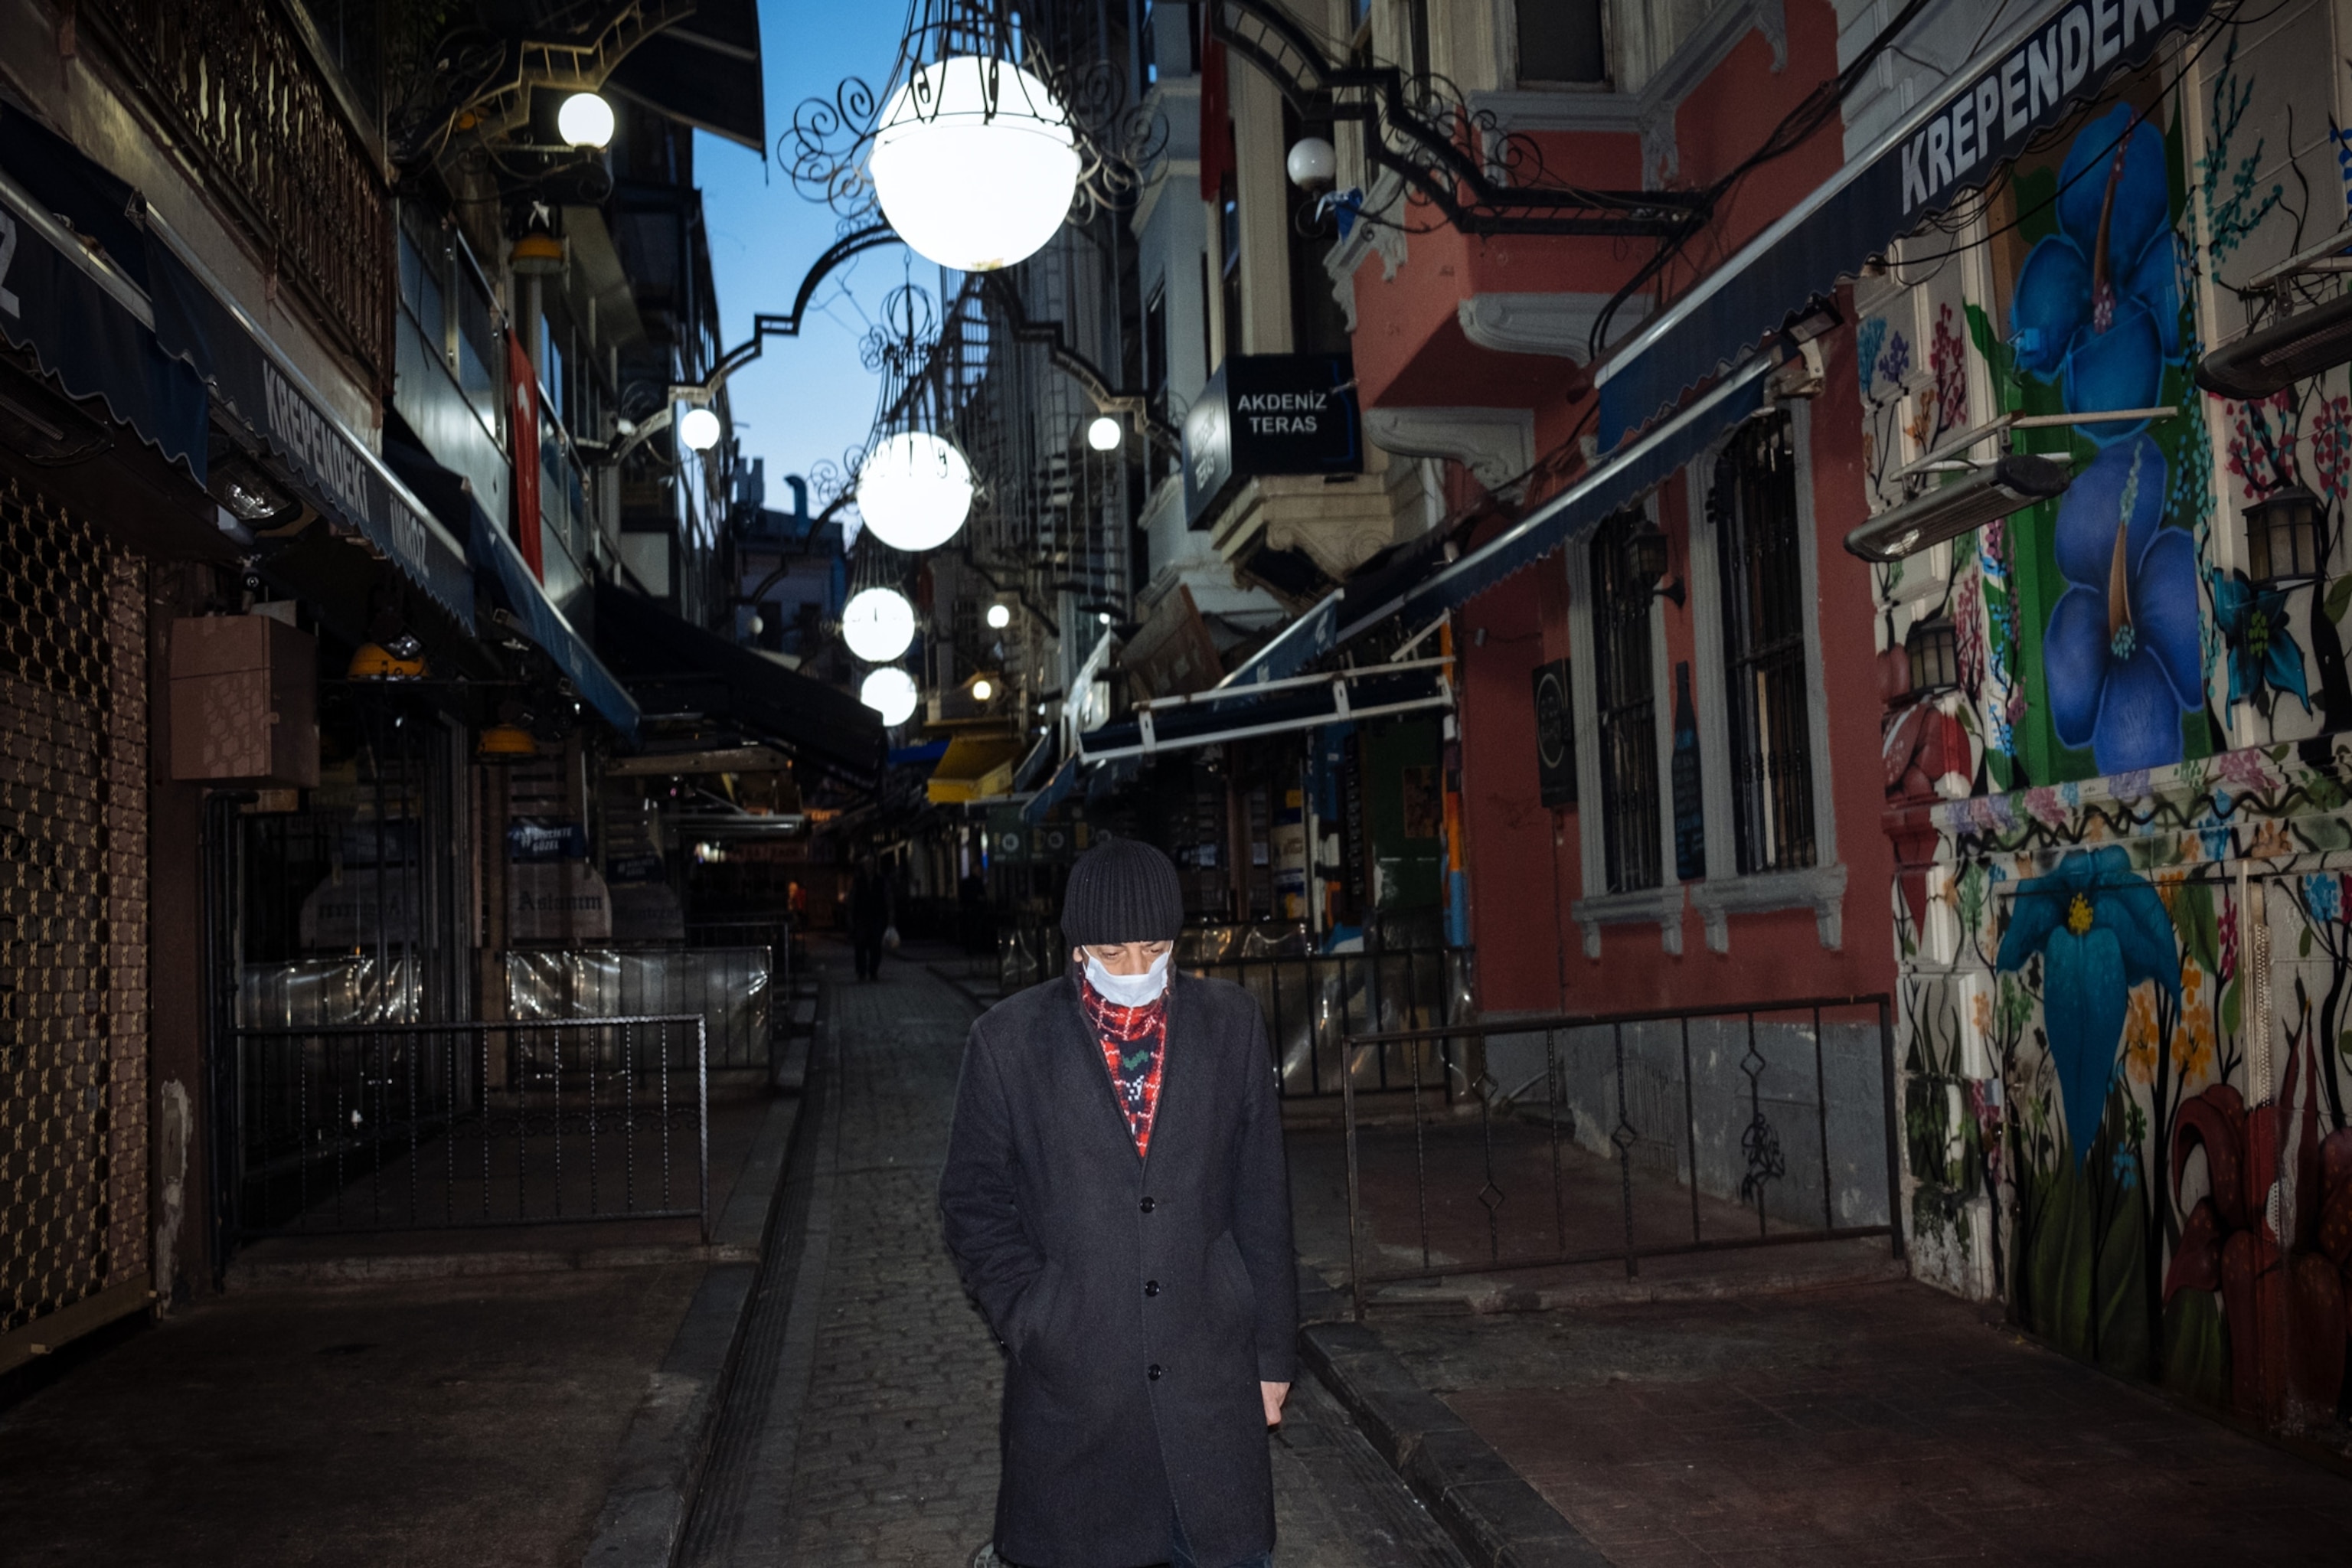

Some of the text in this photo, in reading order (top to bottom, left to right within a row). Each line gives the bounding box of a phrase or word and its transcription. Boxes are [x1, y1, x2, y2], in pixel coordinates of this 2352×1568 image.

[1236, 389, 1328, 413] AKDENİZ
[1248, 415, 1318, 435] TERAS
[263, 358, 430, 580] KREPENDEKİ İMROZ
